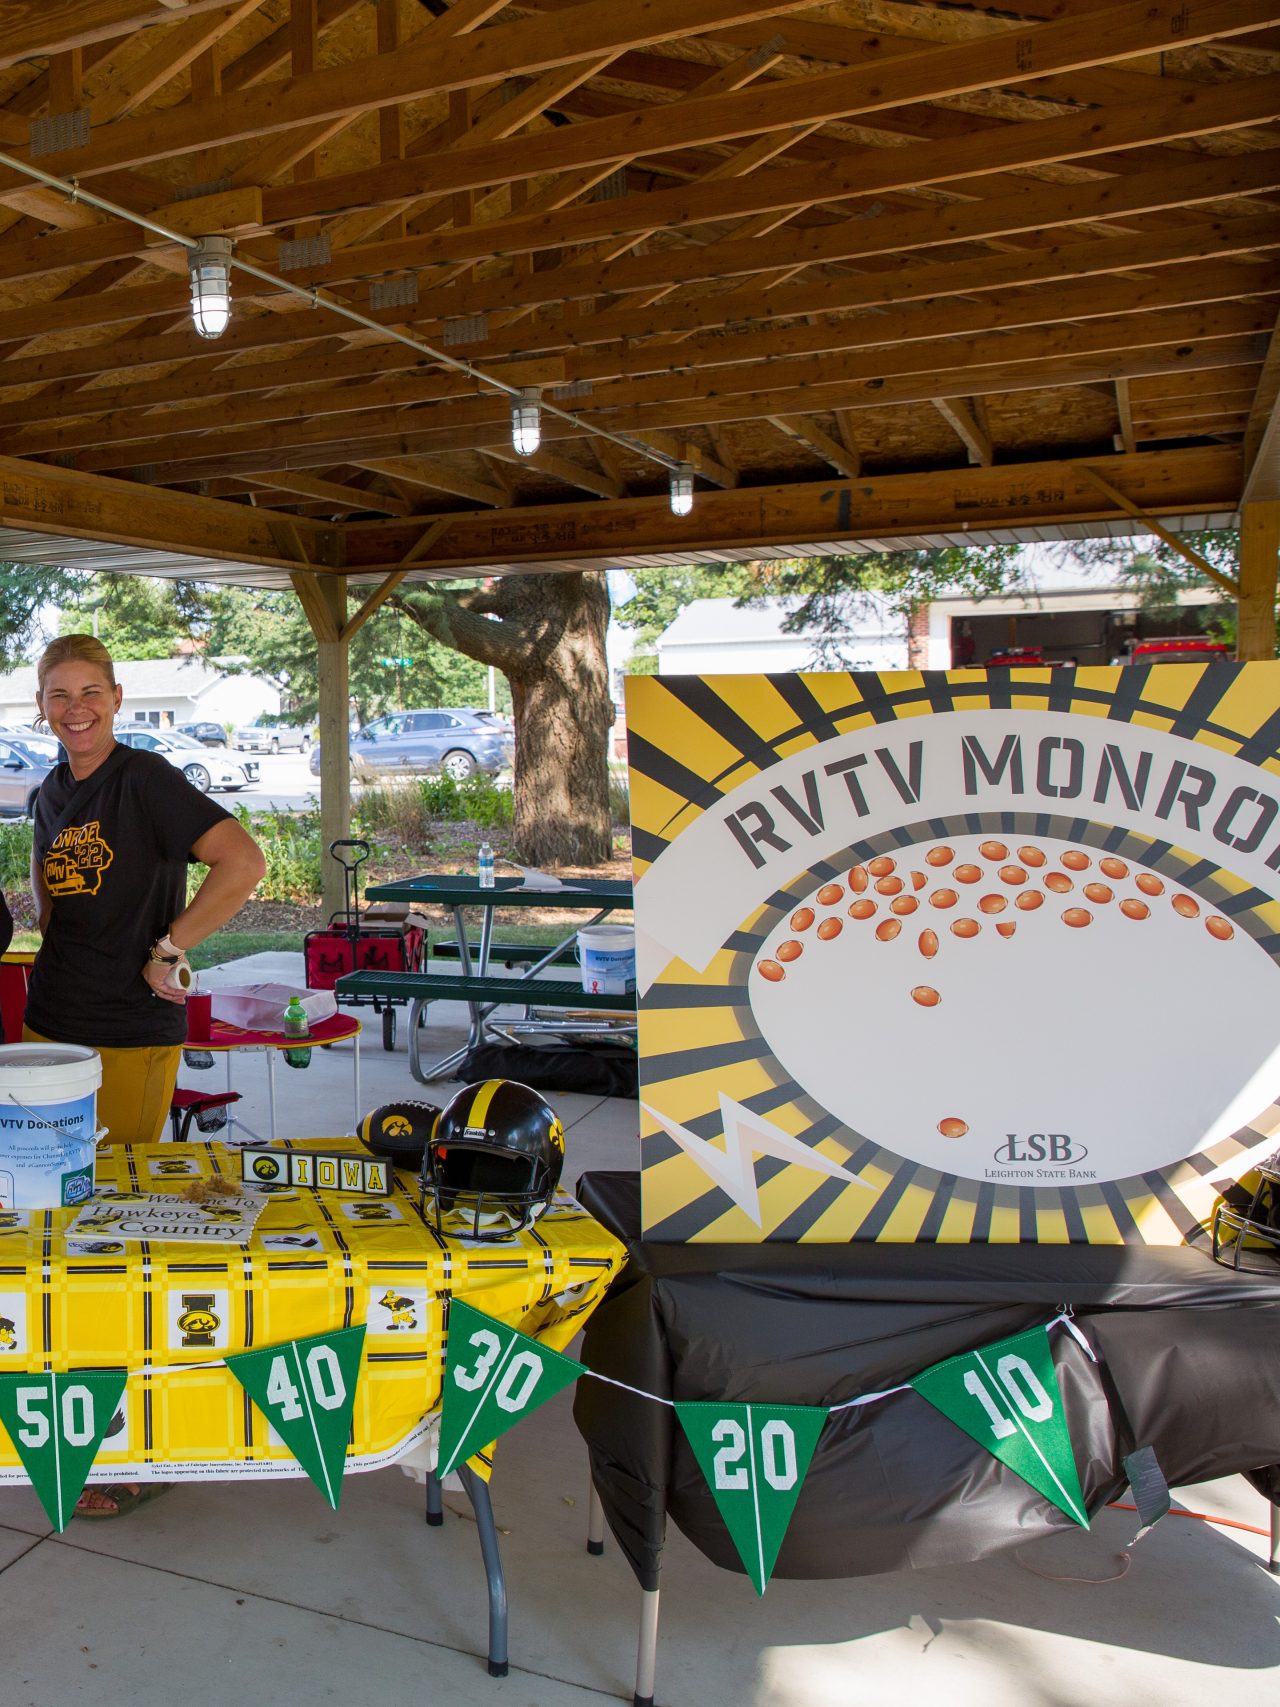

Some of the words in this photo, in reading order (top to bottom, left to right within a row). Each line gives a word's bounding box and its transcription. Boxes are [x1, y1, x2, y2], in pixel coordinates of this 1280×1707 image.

[723, 741, 923, 870] RVTV
[961, 735, 1280, 875] MONRO
[52, 823, 97, 849] ONROE
[27, 1114, 84, 1130] Donations
[464, 1128, 485, 1137] Franklin
[1006, 1134, 1072, 1161] LSB
[297, 1159, 383, 1190] IOWA
[93, 1206, 200, 1222] Hawkeye
[232, 1197, 255, 1208] To
[118, 1221, 247, 1240] Country
[266, 1344, 348, 1422] 40
[453, 1328, 544, 1413] 30
[963, 1353, 1054, 1440] 10
[16, 1385, 95, 1448] 50
[711, 1419, 797, 1491] 20
